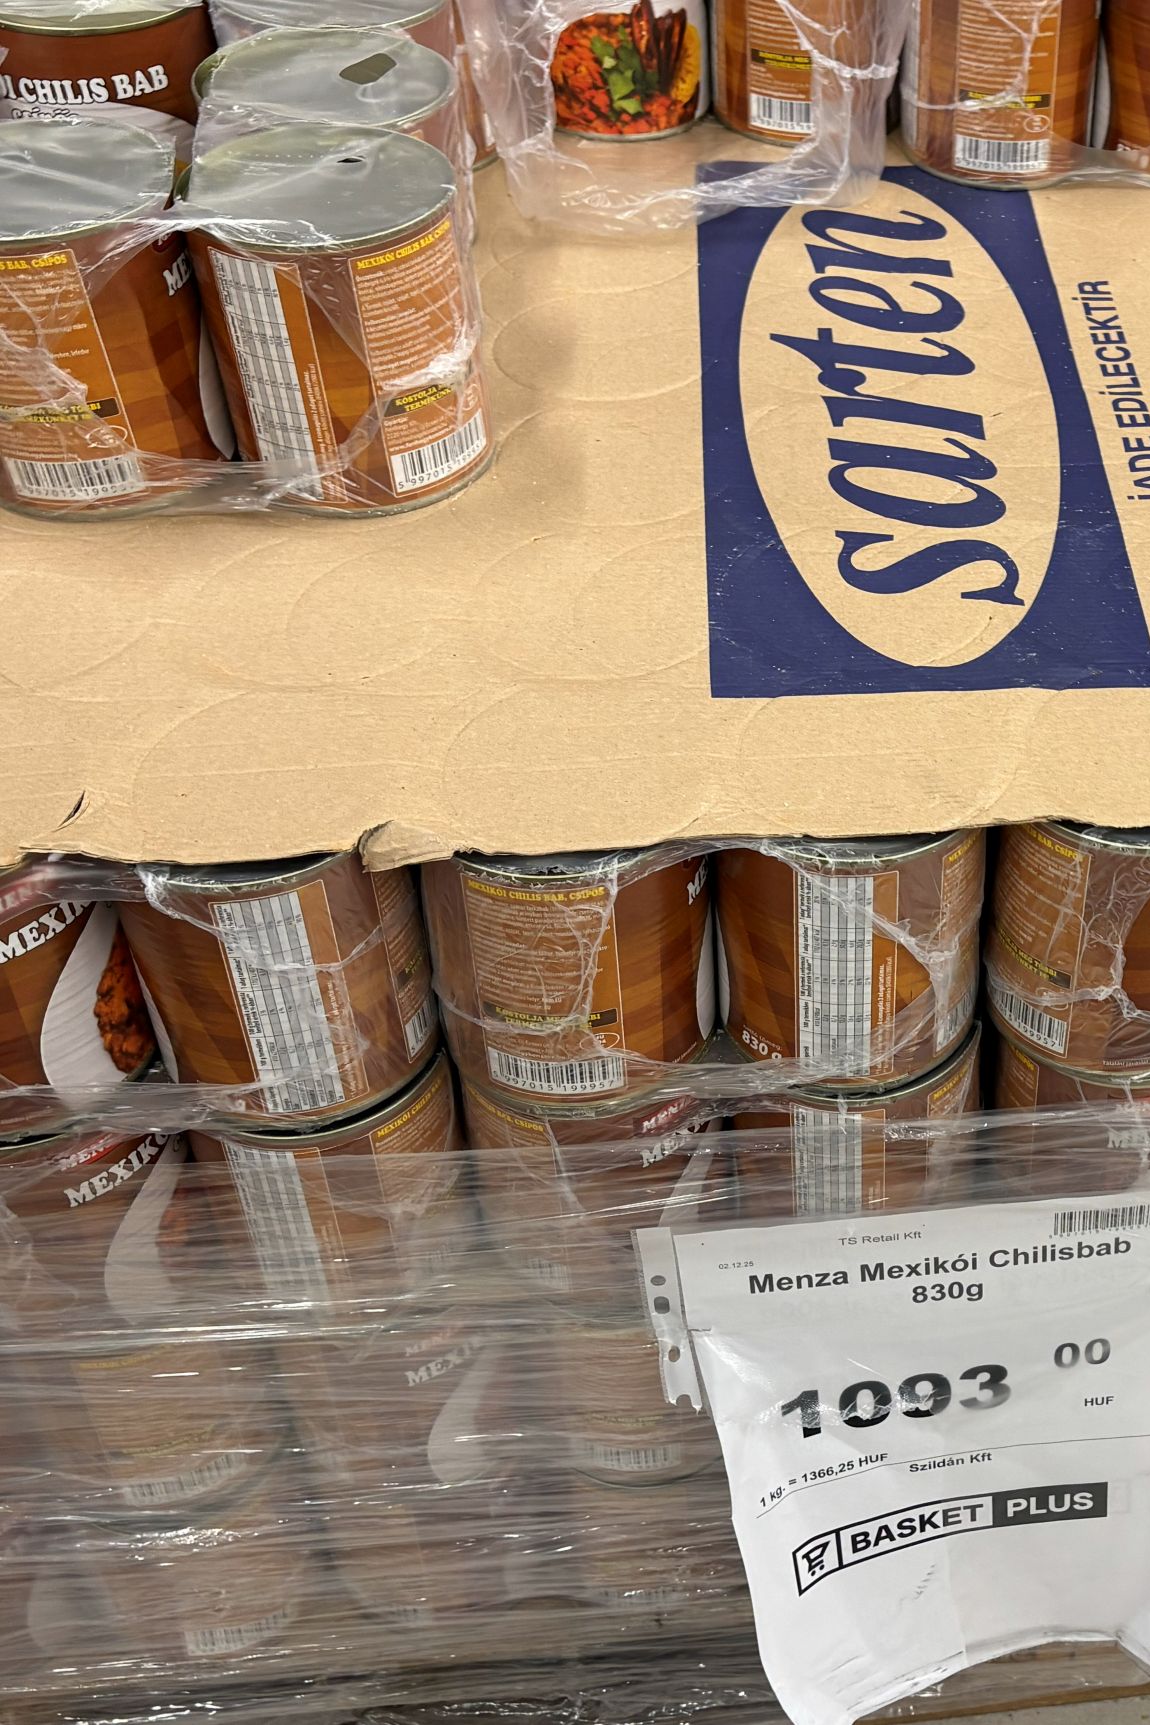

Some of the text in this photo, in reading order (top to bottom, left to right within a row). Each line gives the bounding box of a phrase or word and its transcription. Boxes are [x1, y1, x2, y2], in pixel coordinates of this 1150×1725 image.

[18, 78, 109, 104] CHILIS
[111, 64, 169, 100] BAB
[769, 210, 1025, 606] sarten
[509, 891, 542, 901] CHILIS
[742, 1030, 768, 1055] 830
[1017, 1022, 1056, 1048] 199957
[505, 1075, 553, 1091] 997015
[563, 1080, 613, 1092] 199957
[838, 1231, 922, 1246] TS Retail Kft
[718, 1261, 754, 1270] 02.12.25
[749, 1237, 1131, 1294] Menza Mexikói Chilisbab
[911, 1281, 984, 1304] 830g
[781, 1338, 1111, 1439] 1093 00
[1084, 1396, 1115, 1407] HUF
[909, 1452, 993, 1473] Szildán Kft
[759, 1496, 767, 1508] 1
[788, 1478, 797, 1486] =
[801, 1459, 855, 1483] 1366,25
[858, 1453, 889, 1468] HUF
[850, 1492, 1094, 1554] BASKET PLUS
